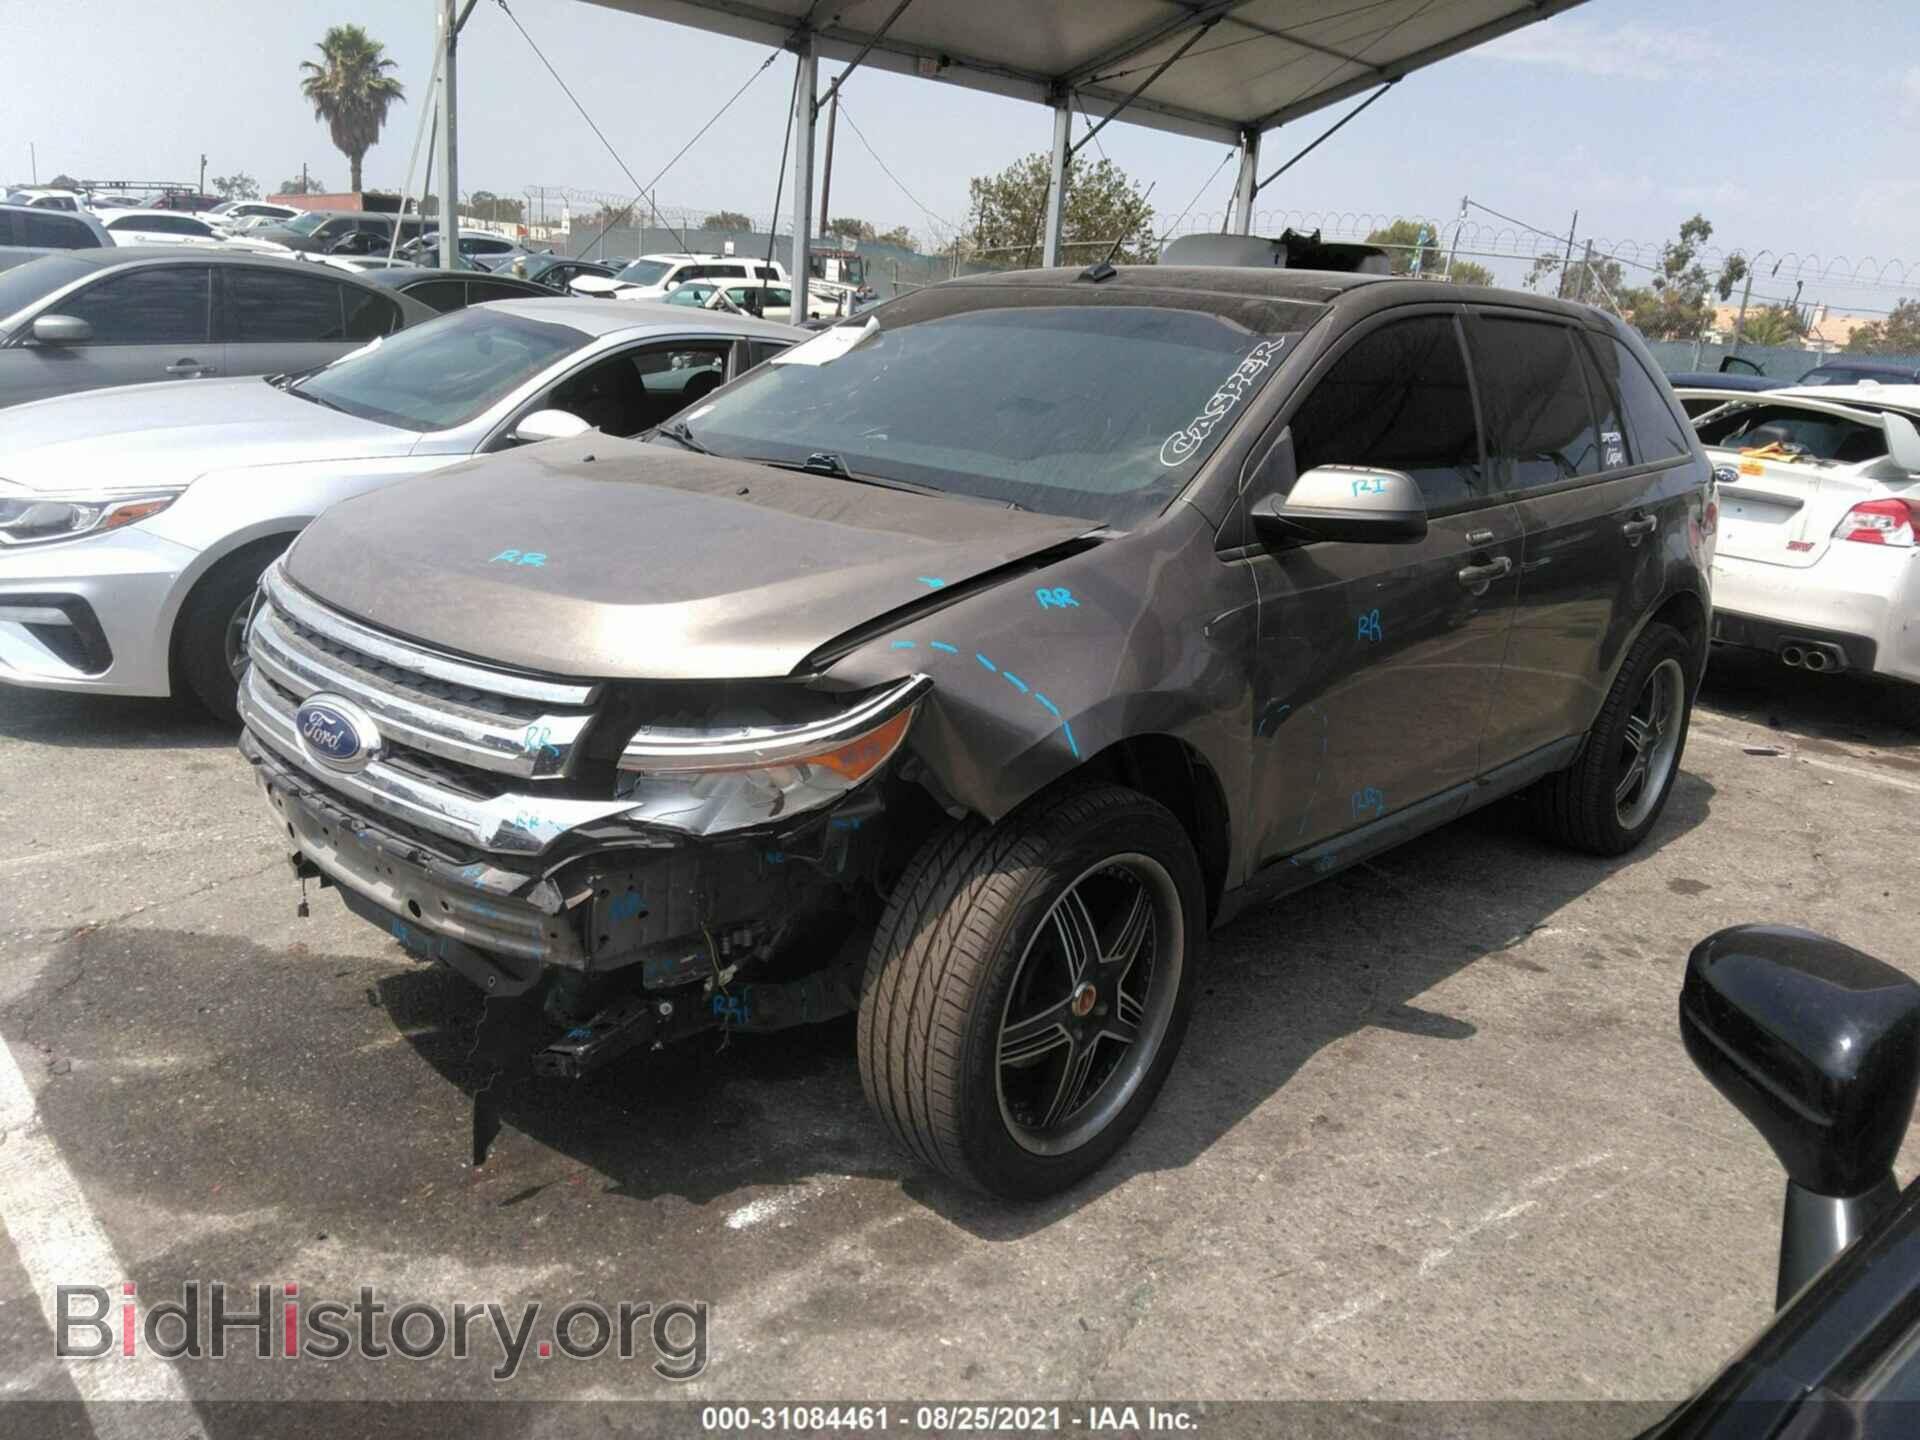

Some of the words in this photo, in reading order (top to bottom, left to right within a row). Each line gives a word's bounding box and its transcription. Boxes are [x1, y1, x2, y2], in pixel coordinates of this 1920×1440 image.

[1160, 335, 1286, 467] CASPER
[1035, 586, 1080, 609] RR
[1357, 609, 1383, 641] RR
[303, 710, 345, 751] Ford
